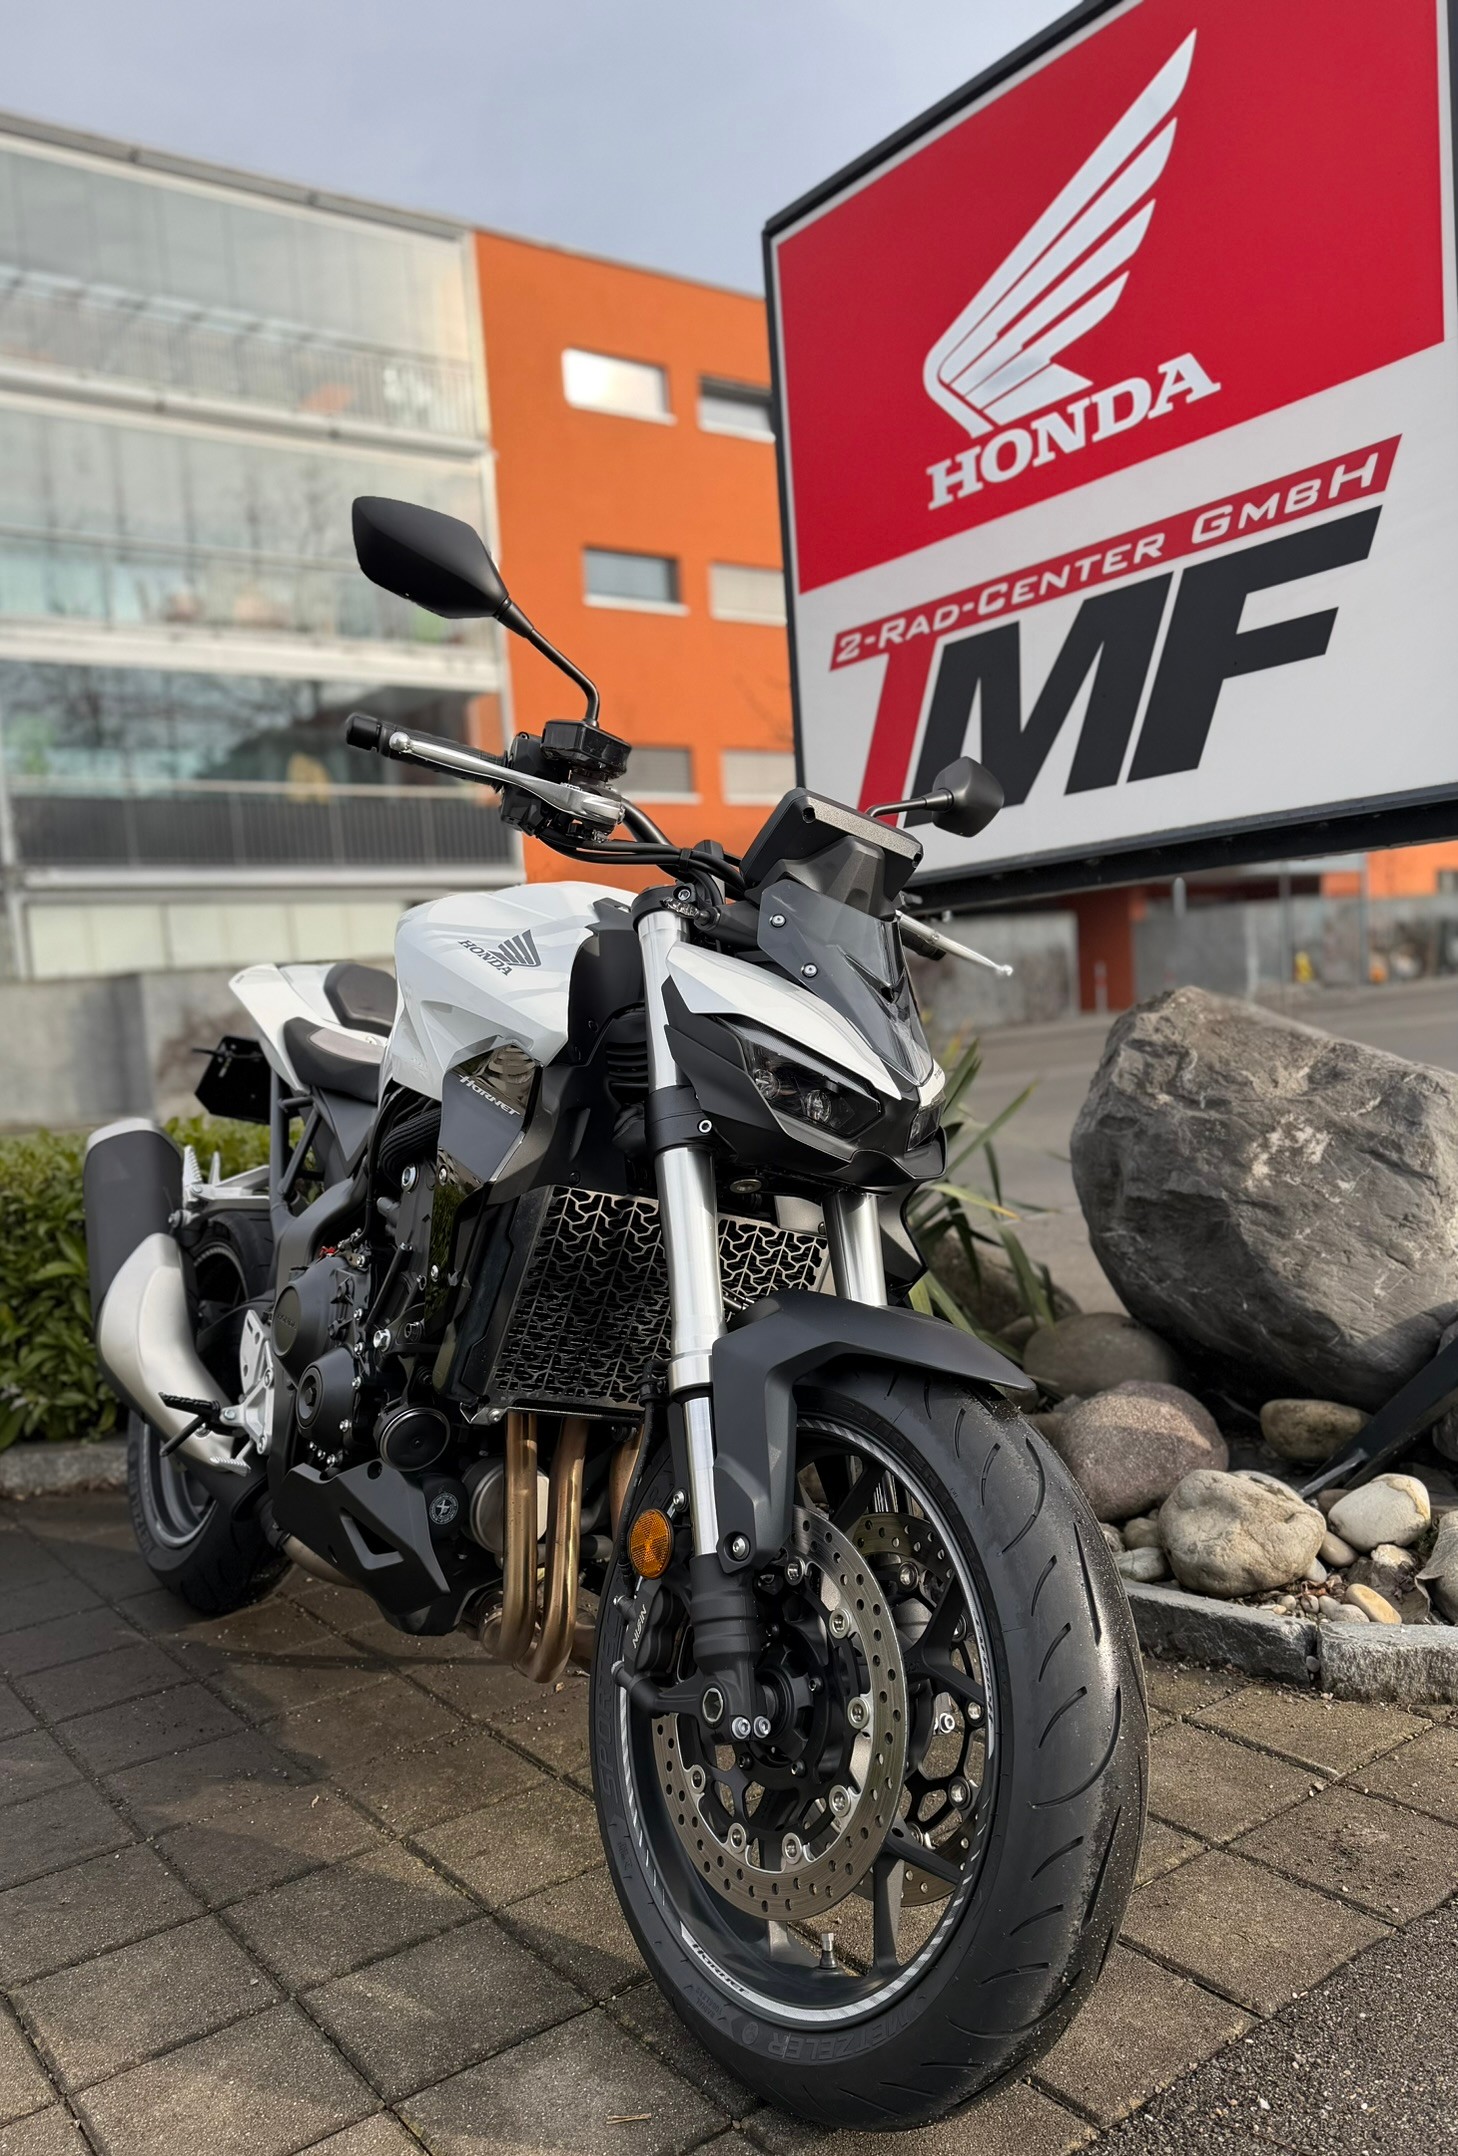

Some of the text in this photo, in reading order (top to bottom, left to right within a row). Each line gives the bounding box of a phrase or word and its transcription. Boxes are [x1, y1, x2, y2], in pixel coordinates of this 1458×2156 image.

[926, 353, 1221, 510] HONDA
[836, 533, 1164, 664] 2-RAD-CENTER
[836, 505, 1382, 829] TMF
[458, 939, 513, 976] HONDA
[767, 2006, 914, 2061] METZELER
